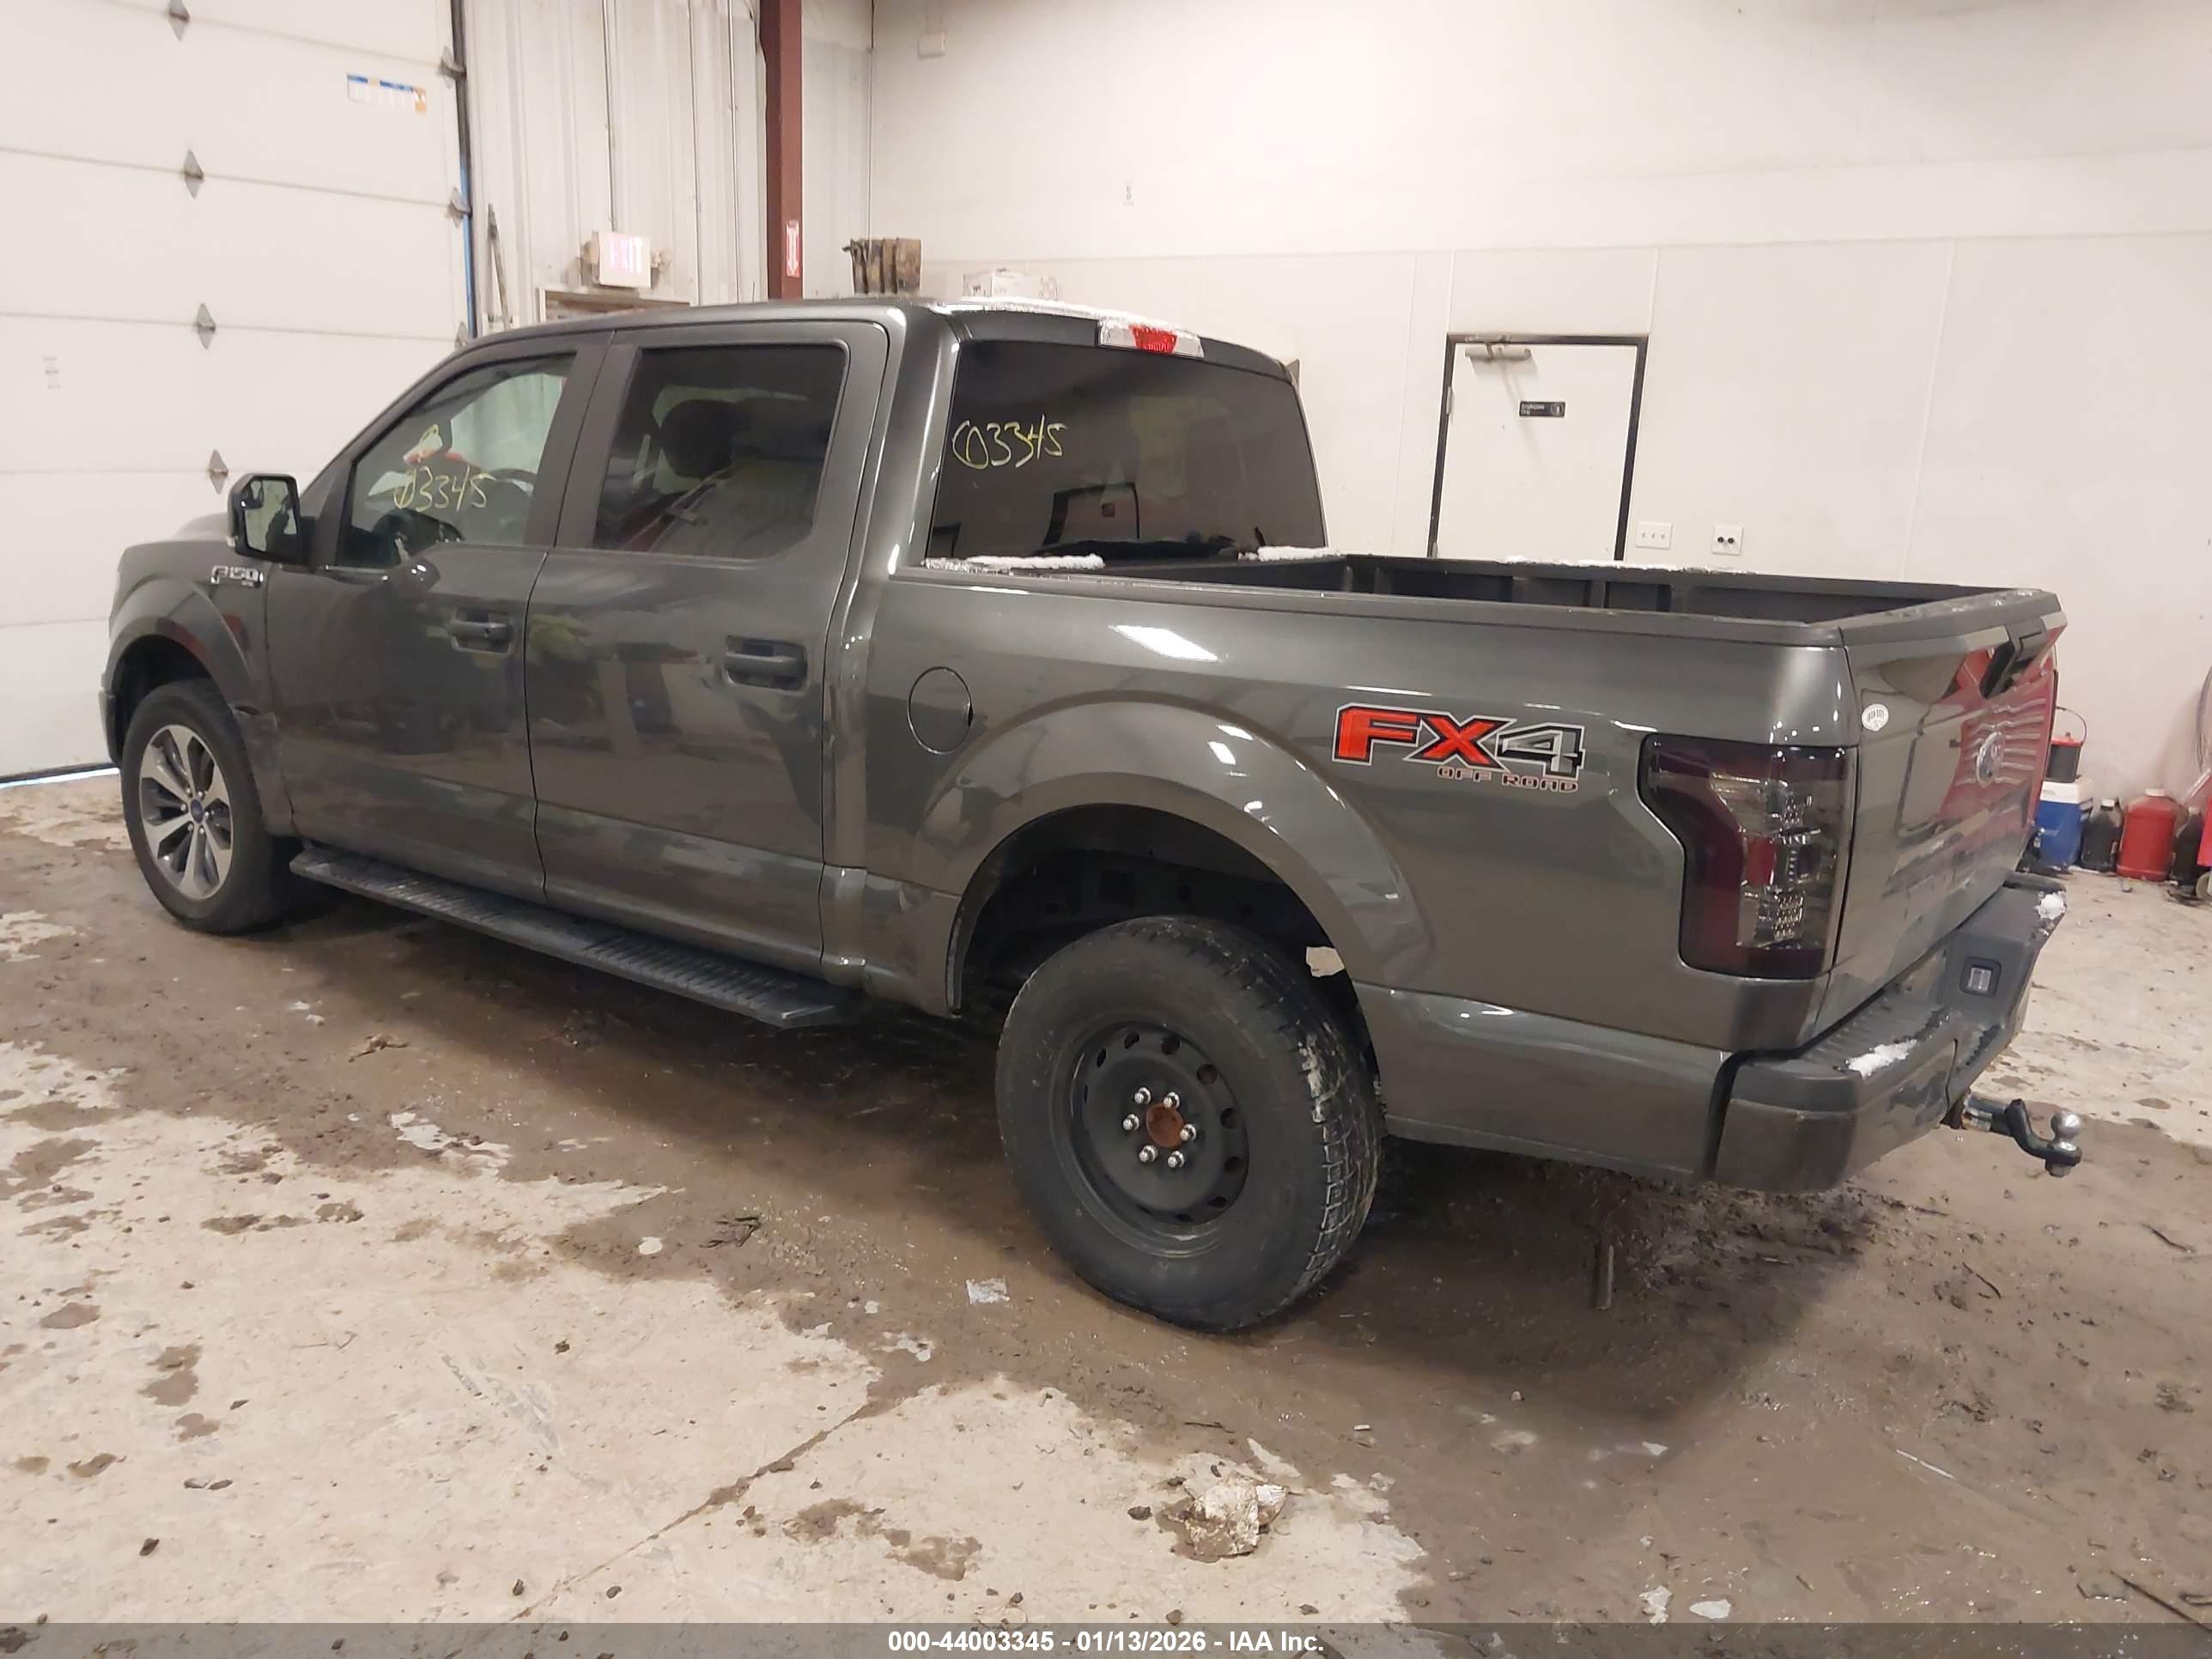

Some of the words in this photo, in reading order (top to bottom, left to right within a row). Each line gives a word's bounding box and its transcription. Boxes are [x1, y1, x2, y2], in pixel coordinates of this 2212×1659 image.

[1332, 702, 1586, 781] FX4
[1437, 766, 1492, 783] OFF
[1502, 773, 1579, 793] ROAD
